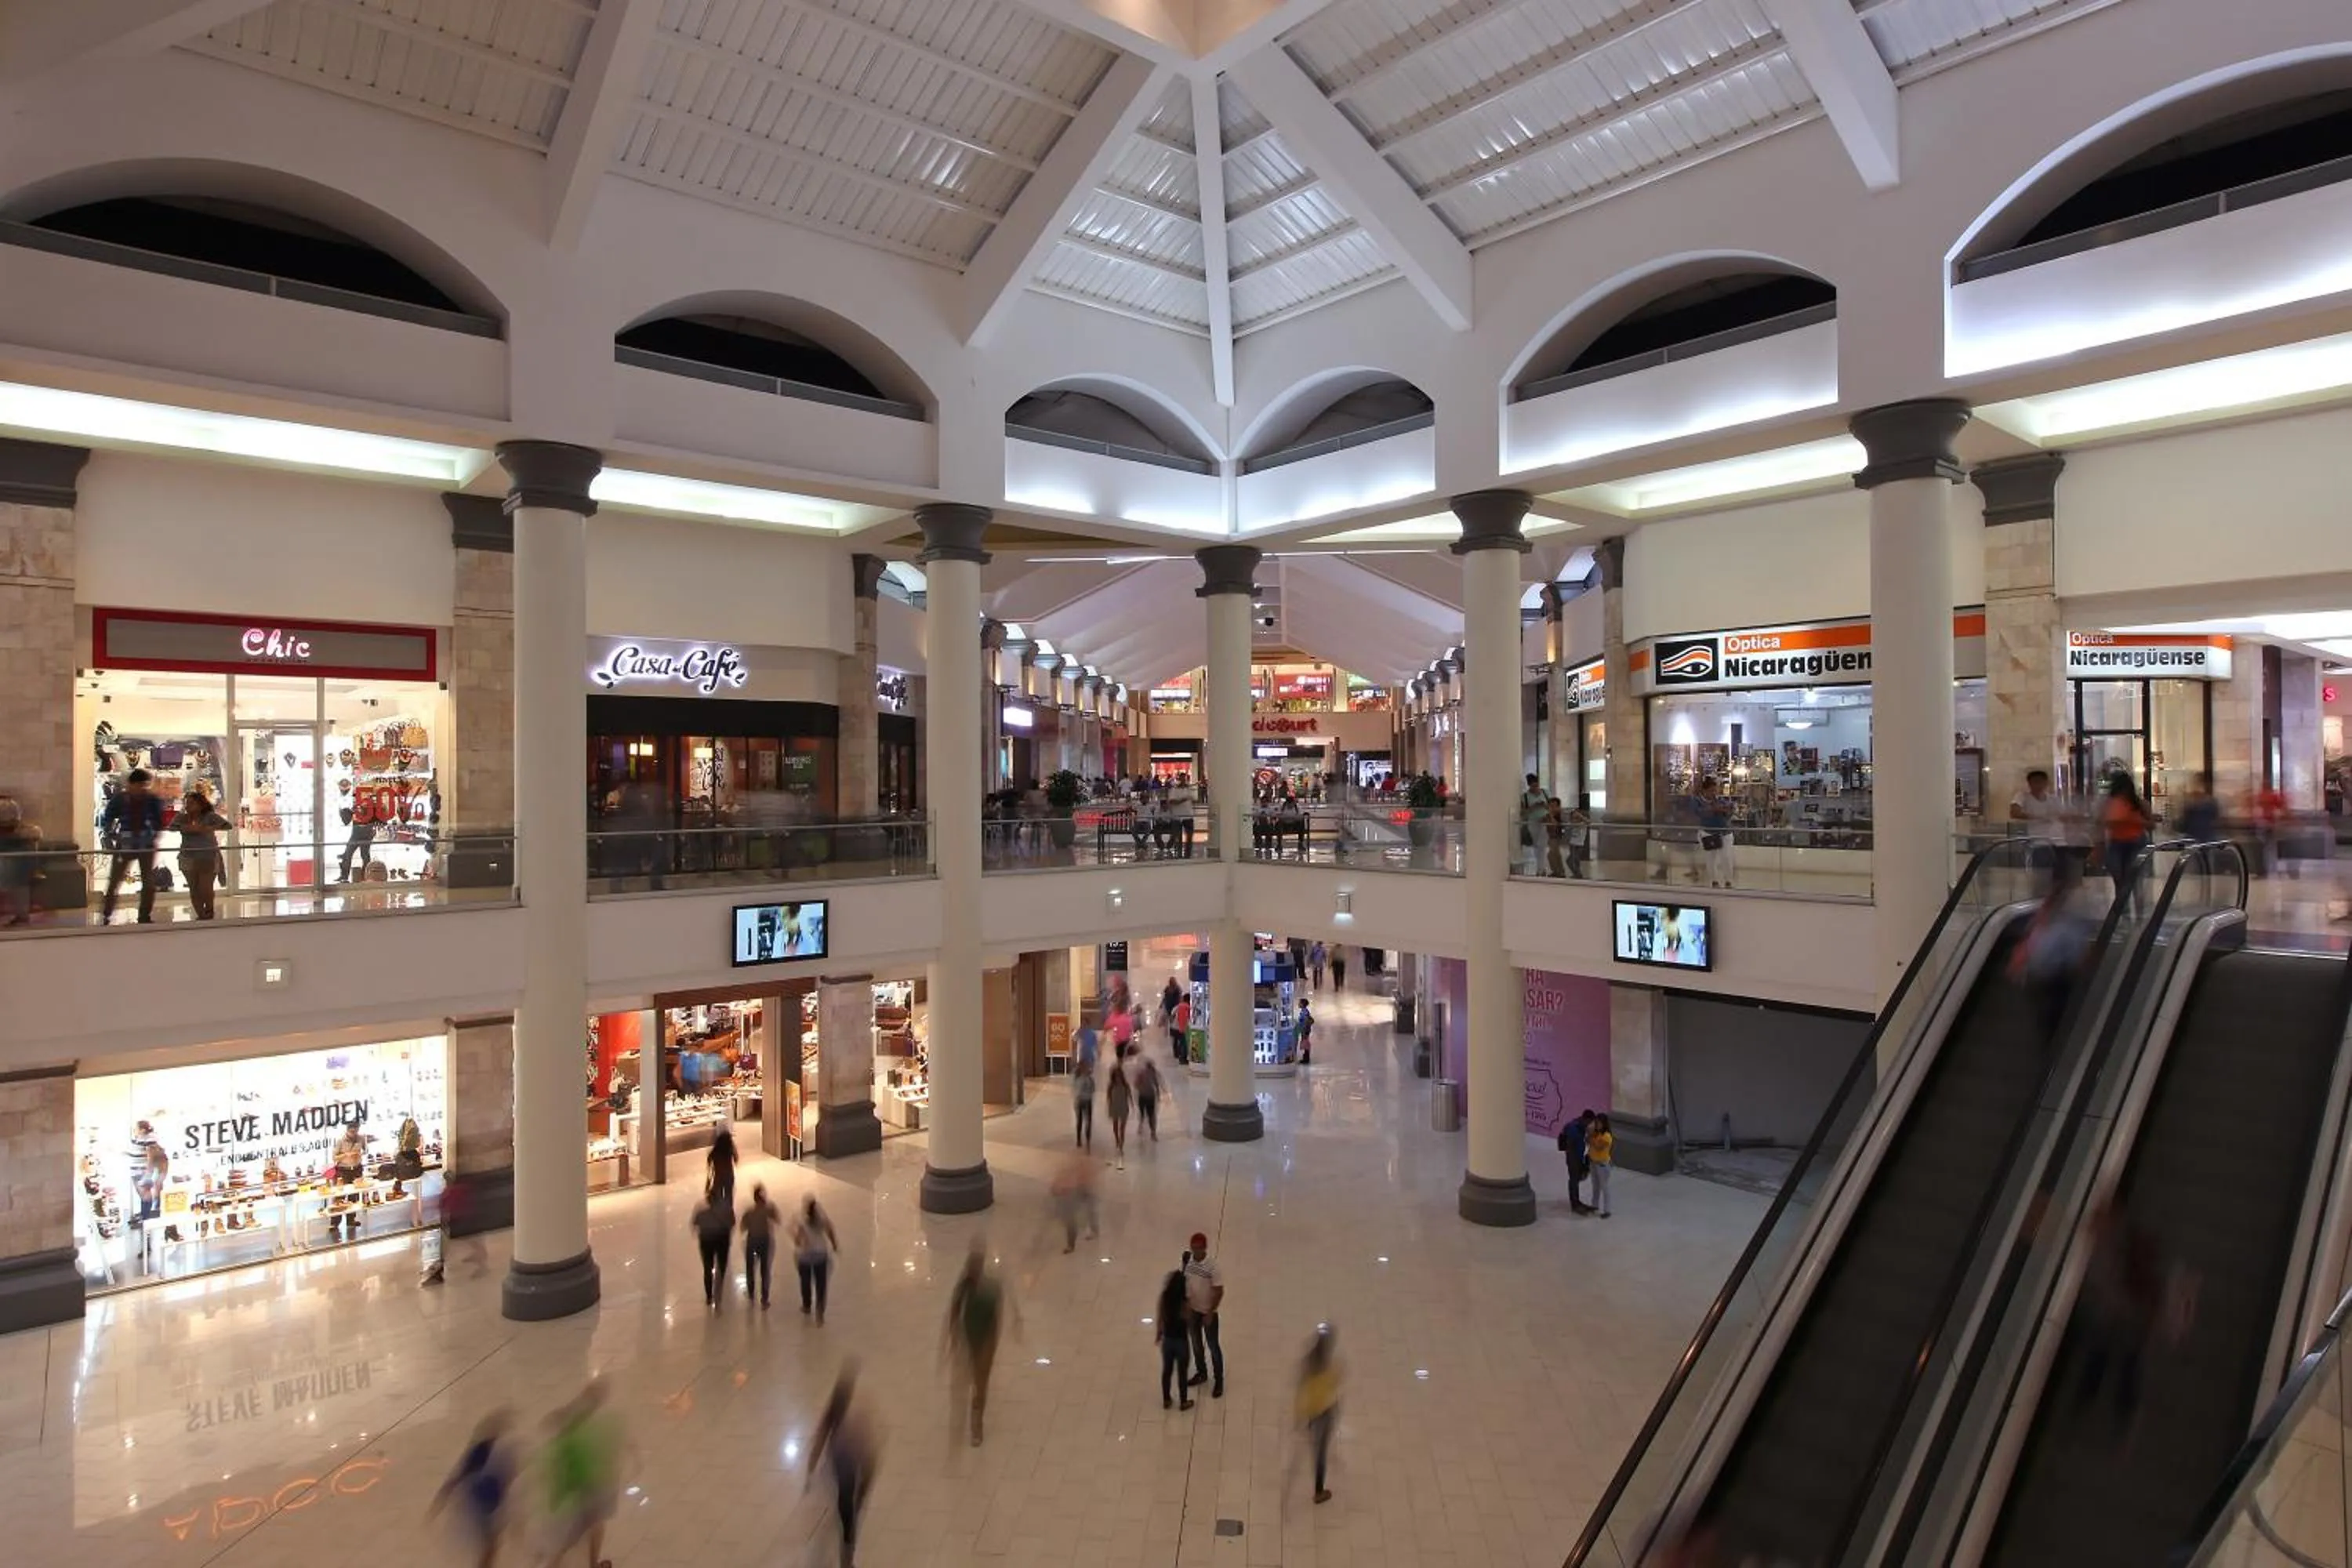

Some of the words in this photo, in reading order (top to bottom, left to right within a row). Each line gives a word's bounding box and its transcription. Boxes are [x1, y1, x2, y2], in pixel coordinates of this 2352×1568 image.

[241, 628, 310, 658] Chic
[1727, 636, 1780, 652] Optica
[612, 647, 672, 677] Casa
[683, 648, 739, 691] Café
[1725, 650, 1871, 677] Nicaragüen
[2070, 648, 2205, 668] Nicaragüense
[185, 1113, 261, 1149] STEVE
[272, 1099, 368, 1137] MADDEN
